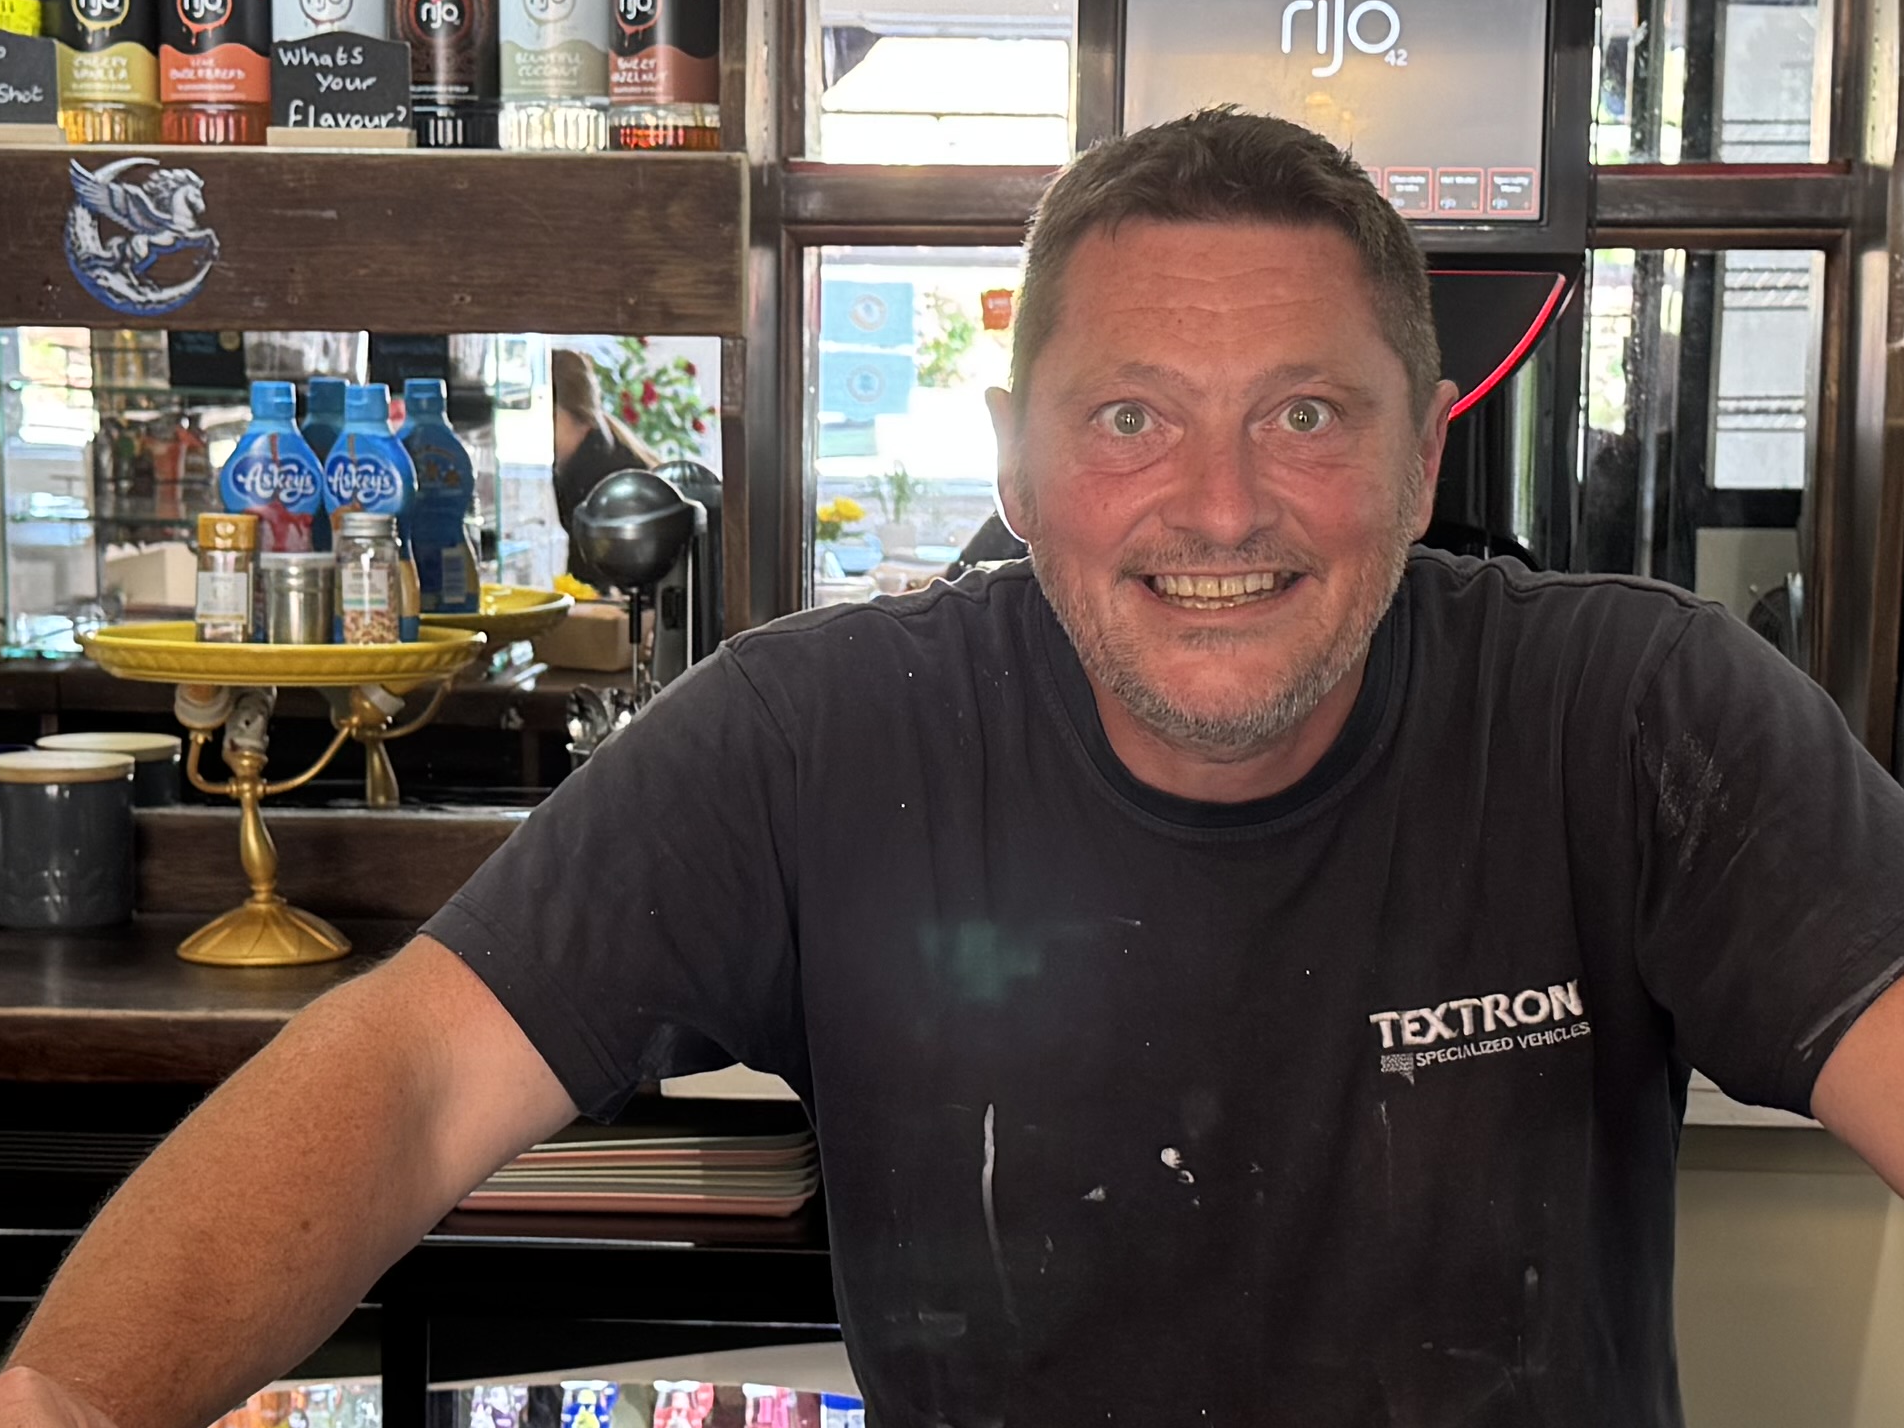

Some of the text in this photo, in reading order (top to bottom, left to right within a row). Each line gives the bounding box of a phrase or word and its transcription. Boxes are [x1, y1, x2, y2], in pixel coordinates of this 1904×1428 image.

[278, 46, 364, 68] Whats
[237, 458, 316, 501] Askey's
[327, 458, 395, 503] Askey's
[1369, 979, 1584, 1049] TEXTRON
[1415, 1020, 1591, 1068] SPECIALIZED VEHICLES
